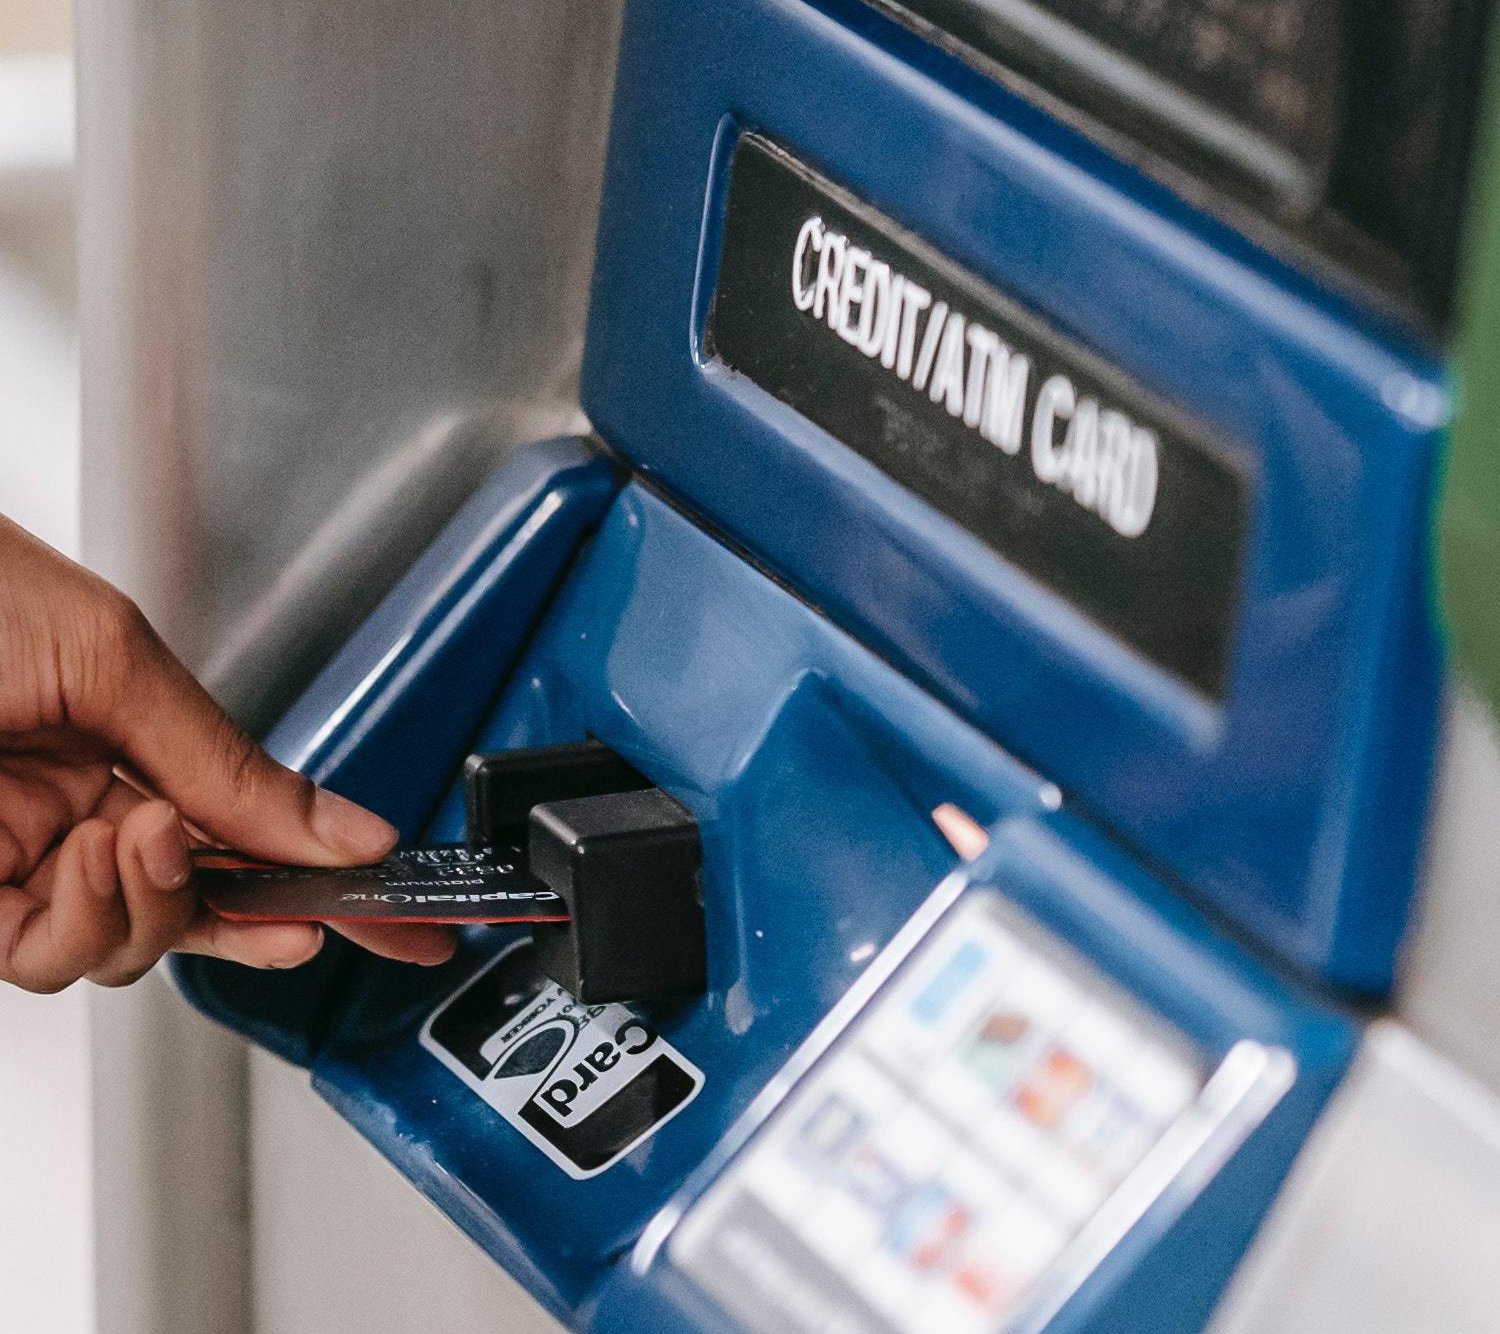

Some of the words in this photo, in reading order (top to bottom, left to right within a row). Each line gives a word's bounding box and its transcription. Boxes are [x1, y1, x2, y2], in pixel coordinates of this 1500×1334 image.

[792, 215, 1029, 456] CREDIT/ATM
[1030, 374, 1160, 539] CARD
[385, 877, 485, 887] platinum
[540, 1017, 659, 1117] Card
